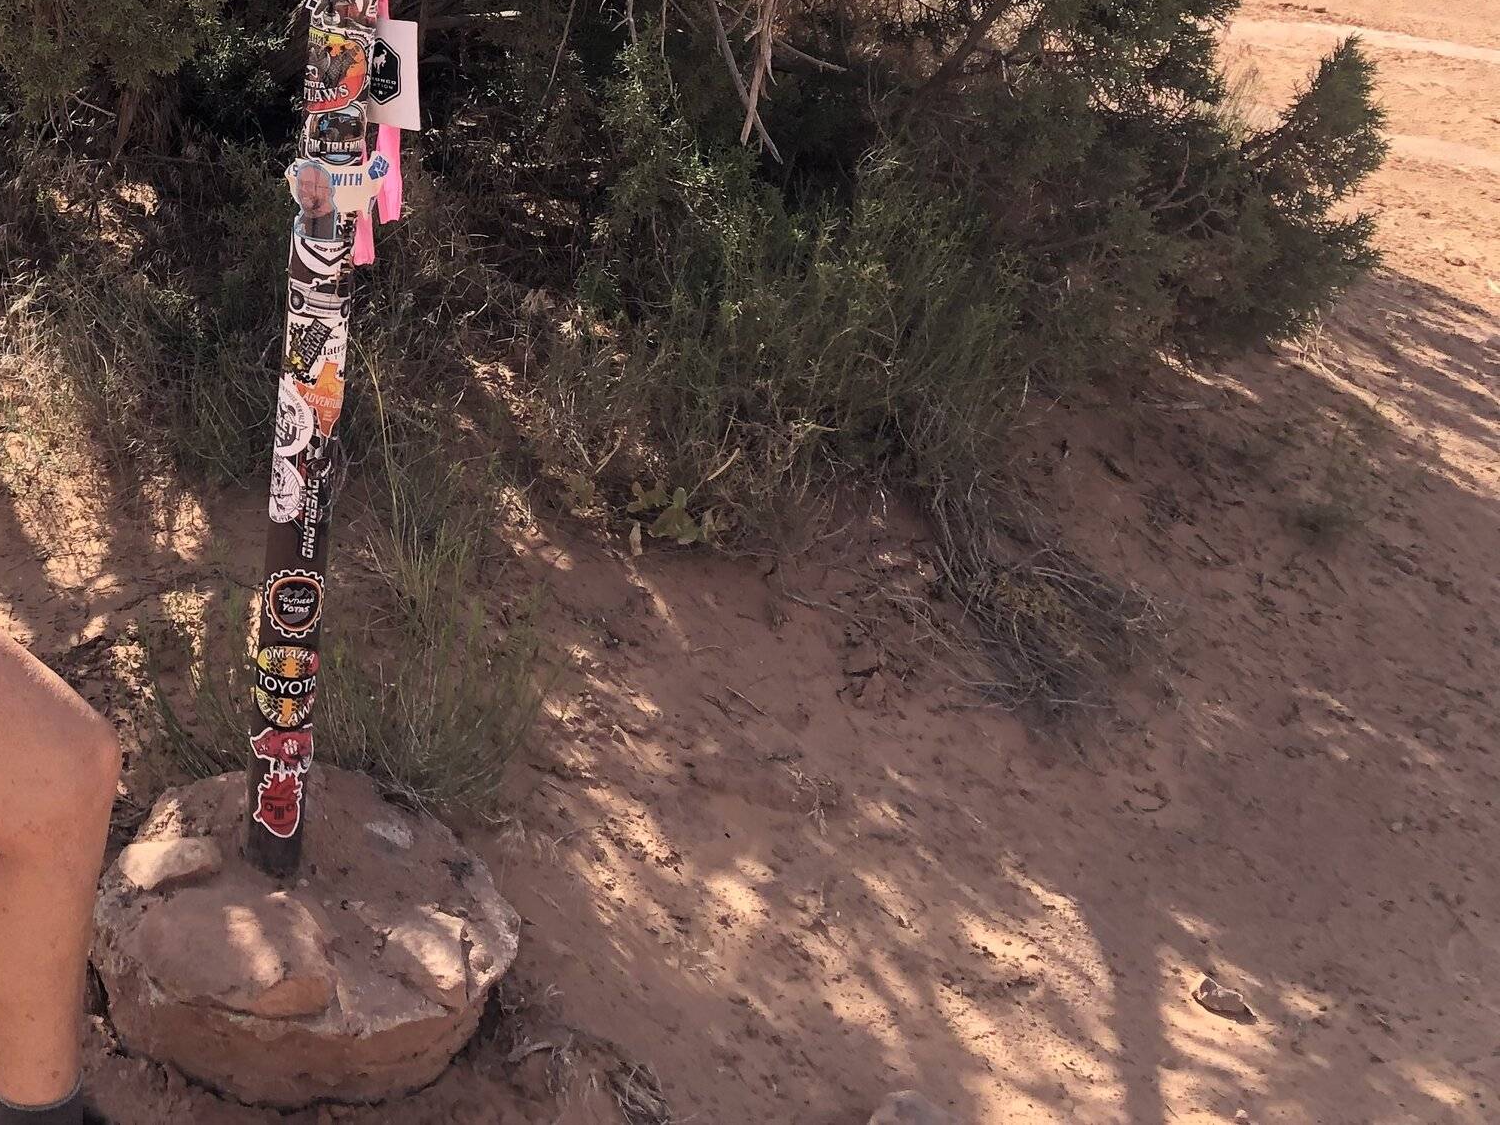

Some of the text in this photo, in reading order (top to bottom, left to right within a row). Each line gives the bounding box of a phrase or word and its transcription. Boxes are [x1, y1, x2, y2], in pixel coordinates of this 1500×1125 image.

[331, 173, 363, 186] WITH
[301, 478, 320, 559] OVERLAND
[265, 648, 315, 665] OMAHA
[258, 669, 317, 696] TOYOTA
